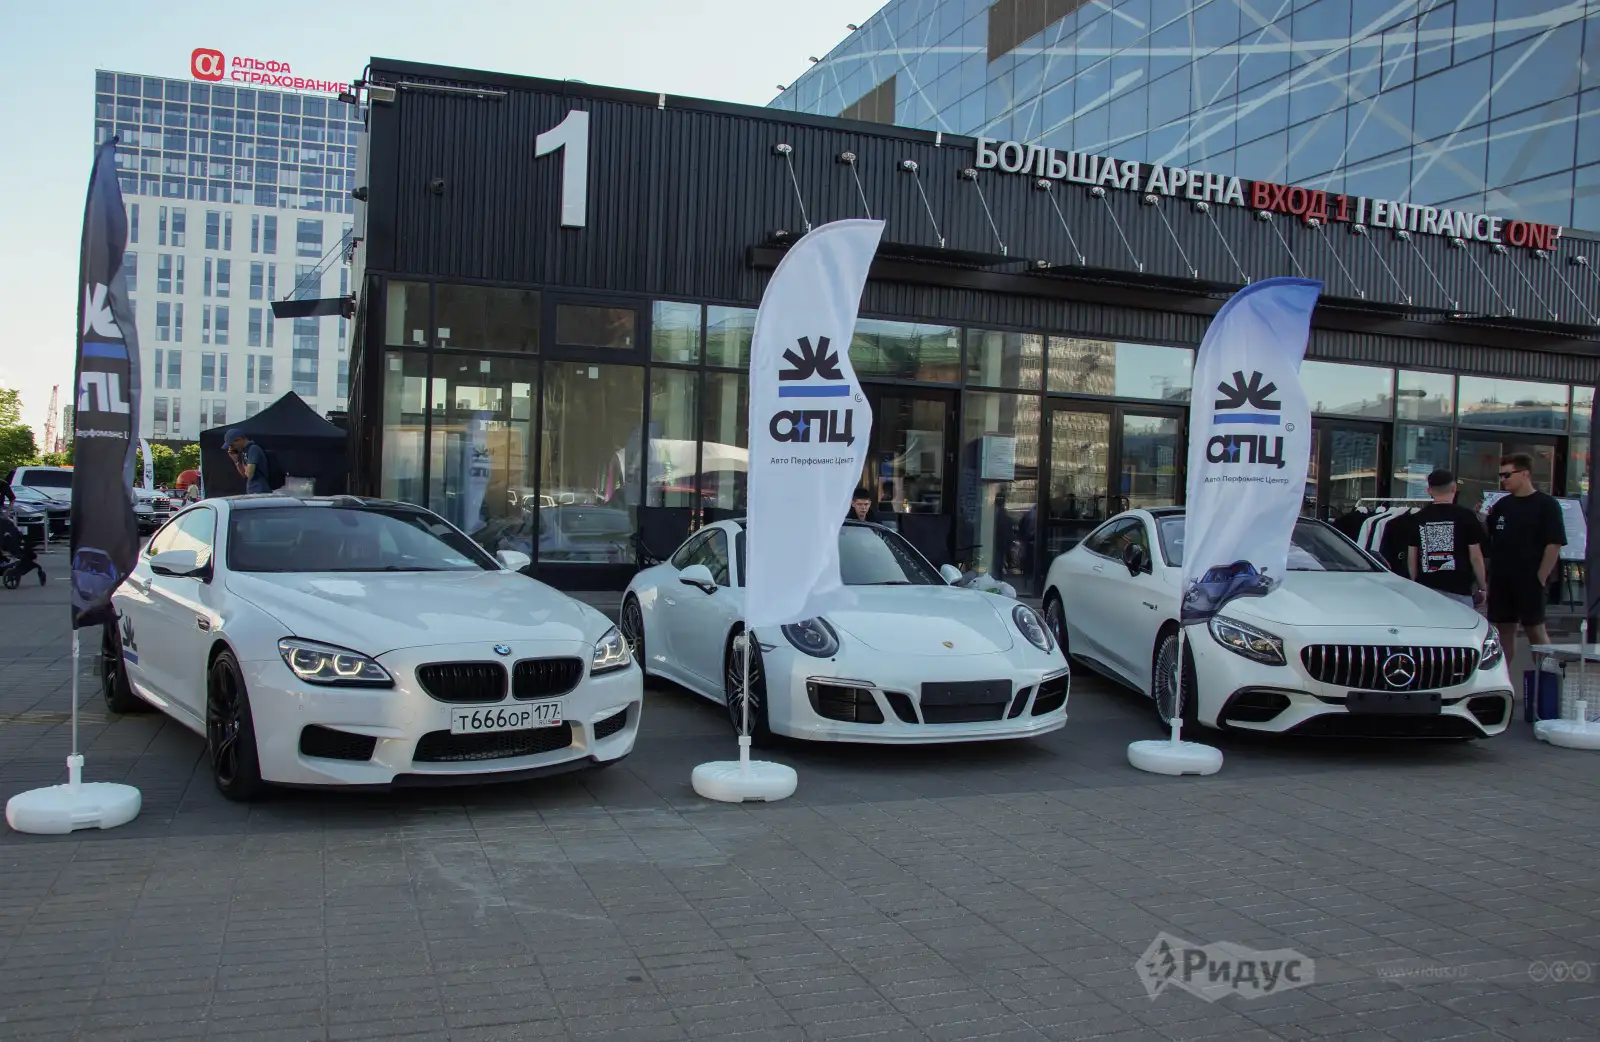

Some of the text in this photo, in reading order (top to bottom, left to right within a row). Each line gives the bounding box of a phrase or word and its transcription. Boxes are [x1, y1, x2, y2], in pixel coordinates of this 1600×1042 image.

[231, 56, 291, 74] АЛЬФА
[231, 70, 348, 93] СТРАХОВАНИЕ
[535, 109, 589, 227] 1
[976, 136, 1140, 191] БОЛЬШАЯ
[1145, 164, 1245, 206] АРЕНА
[1251, 181, 1327, 225] ВХОД
[1371, 199, 1503, 244] ENTRANCE
[1506, 218, 1559, 251] ONE
[770, 457, 789, 465] Авто
[459, 704, 558, 730] Т666ОР 177
